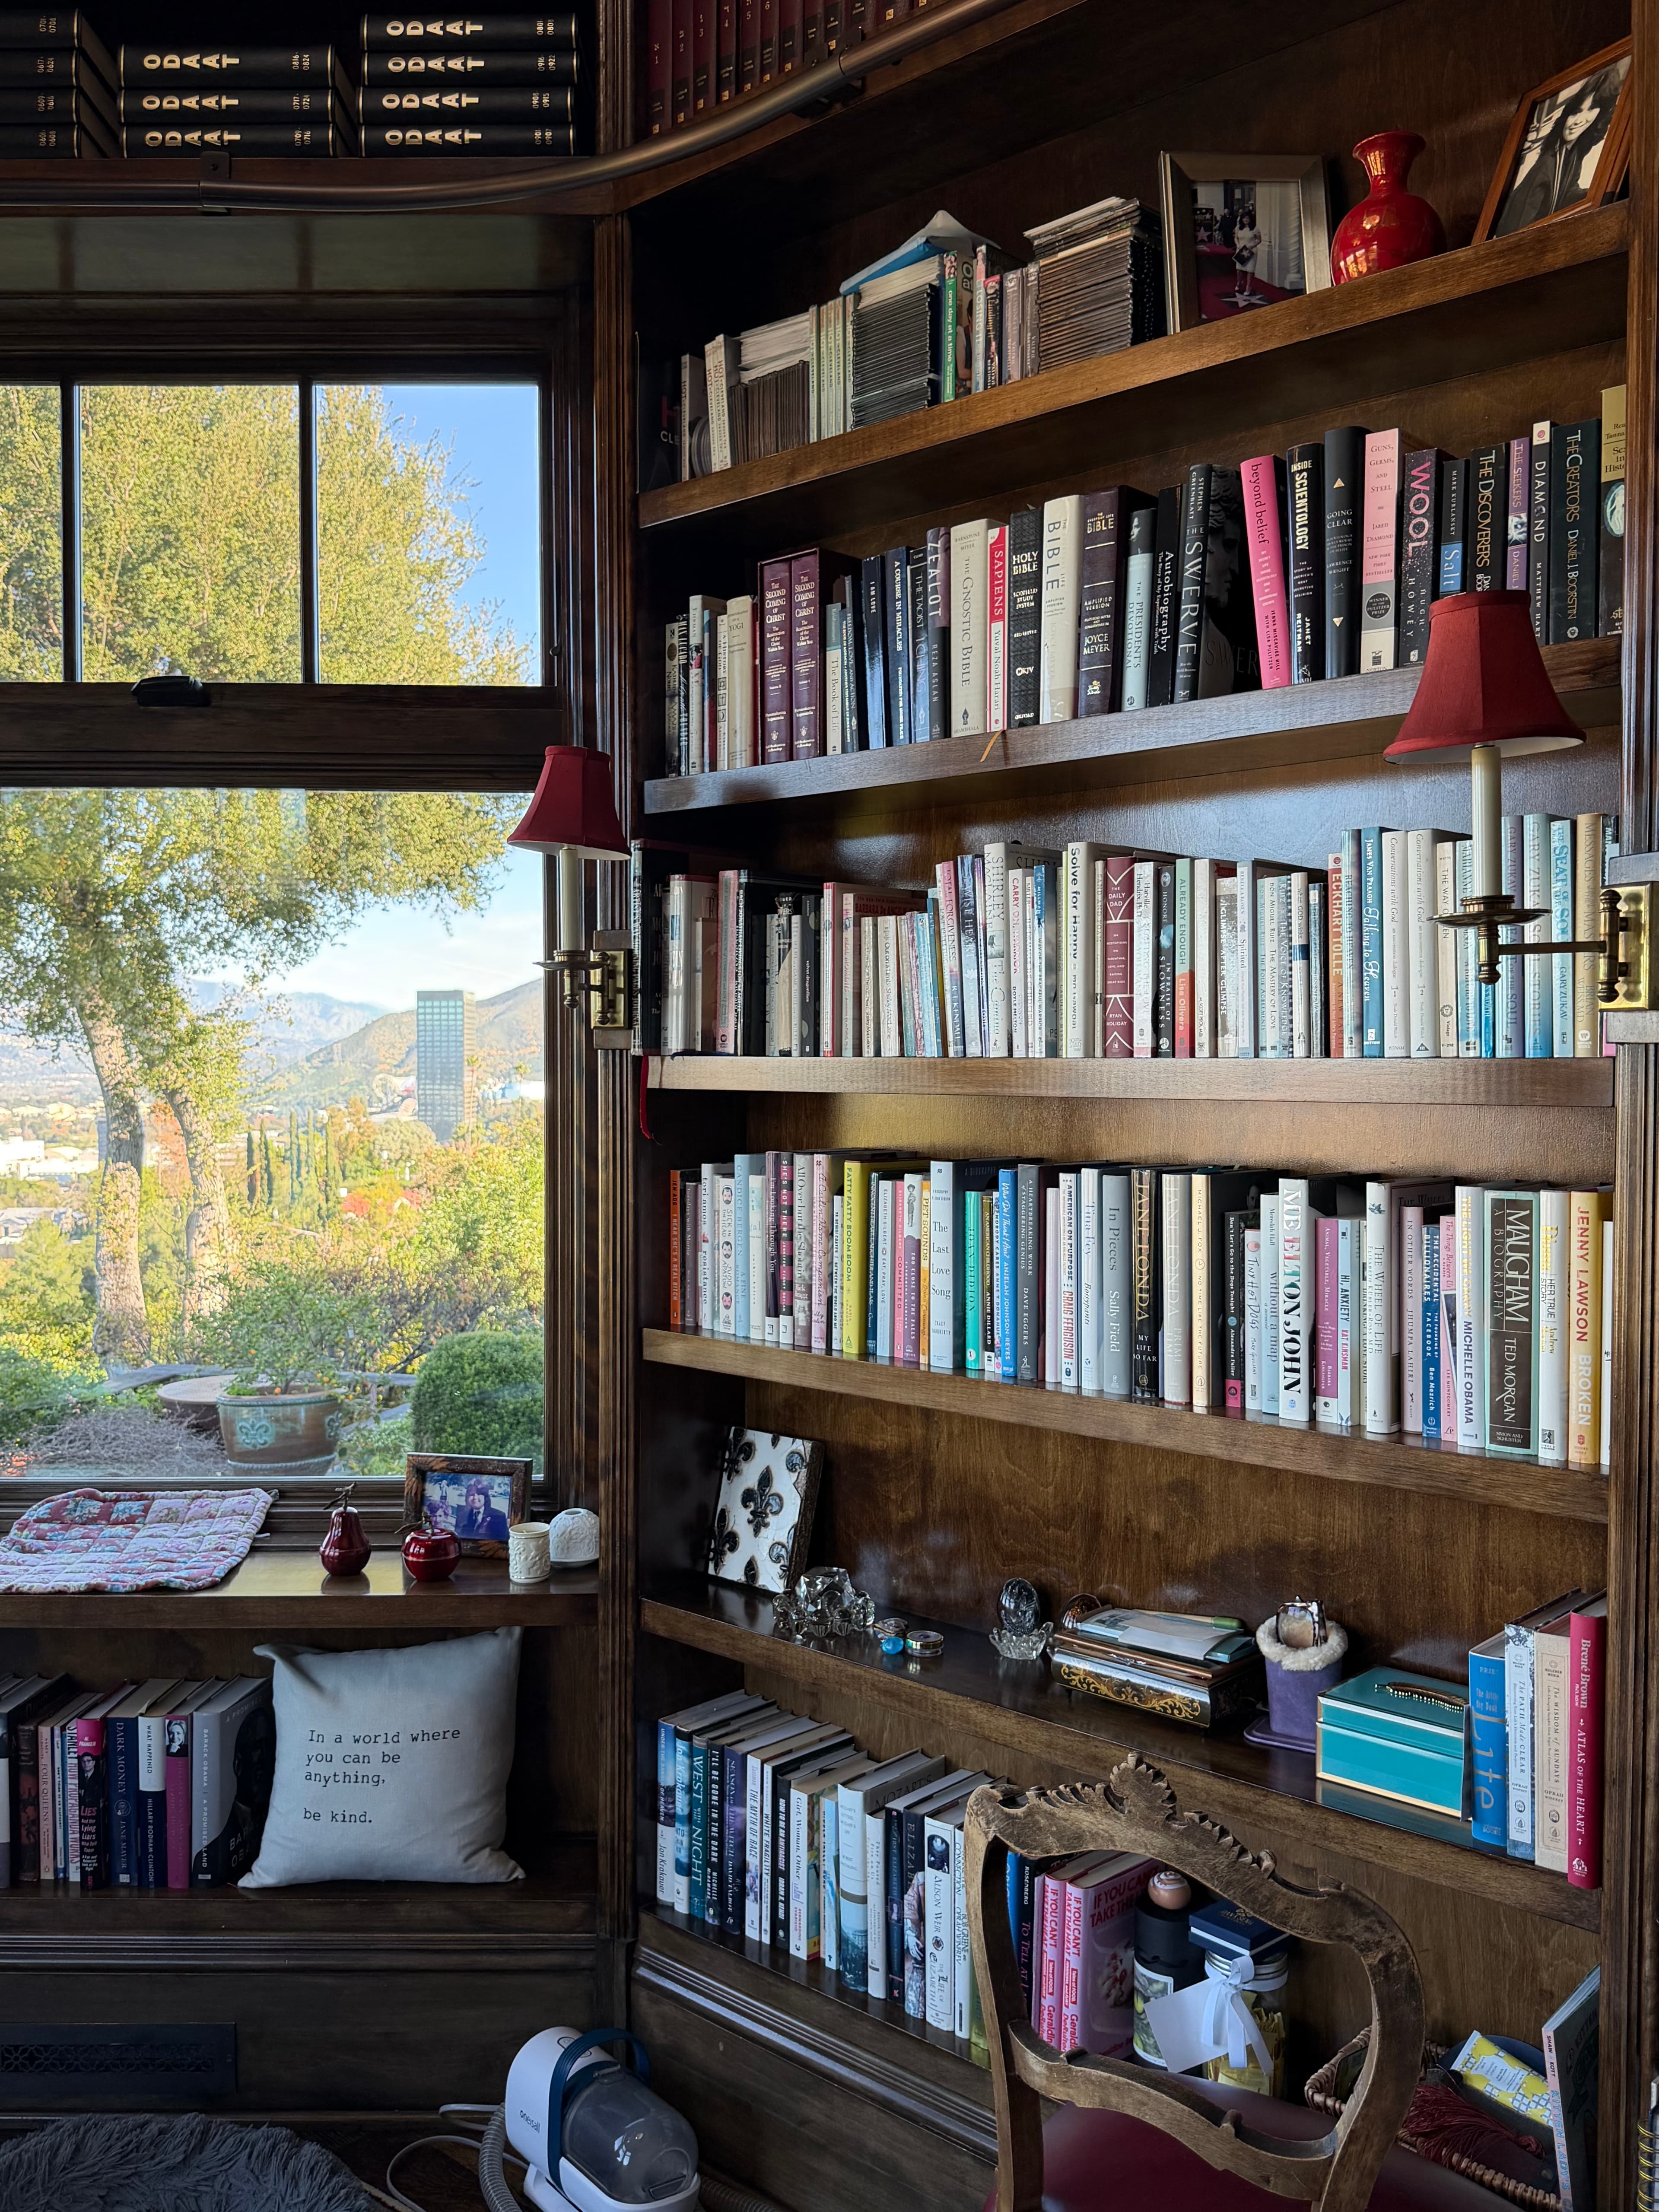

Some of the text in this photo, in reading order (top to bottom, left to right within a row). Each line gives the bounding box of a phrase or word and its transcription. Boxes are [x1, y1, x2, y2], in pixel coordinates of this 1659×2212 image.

[386, 20, 483, 36] ODAAT
[143, 53, 239, 70] ODAAT
[388, 56, 485, 73] ODAAT
[142, 95, 239, 110] ODAAT
[382, 92, 479, 109] ODAAT
[145, 130, 241, 146] ODAAT
[385, 129, 482, 145] ODAAT
[1370, 443, 1394, 454] GUNS,
[1370, 456, 1395, 467] GERMS,
[1249, 463, 1270, 544] beyond belief
[1291, 459, 1312, 550] INSIDE SCIENTOLOGY
[1370, 483, 1392, 493] STEEL
[1408, 461, 1431, 558] WOOL
[1513, 467, 1522, 508] SEEKERS
[1566, 454, 1583, 522] CREATORS
[1087, 517, 1115, 534] BIBLE
[1327, 509, 1353, 519] GOING
[1327, 518, 1353, 529] CLEAR
[1366, 532, 1394, 542] DIAMOND
[1372, 522, 1389, 530] JARED
[1476, 479, 1495, 568] DISCOVERERS
[928, 540, 941, 617] ZEALOT
[1013, 551, 1038, 564] HOLY
[1013, 562, 1038, 575] BIBLE
[1046, 520, 1062, 591] BIBLE
[1443, 549, 1460, 586] Salt
[995, 550, 1003, 616] SAPIENS
[1158, 551, 1174, 652] Autobiography
[1178, 527, 1205, 656] THE SWERVE
[1567, 570, 1579, 620] BOORSTIN
[729, 622, 744, 632] YOGI
[766, 613, 785, 624] CHRIST
[795, 607, 815, 618] CHRIST
[961, 576, 974, 686] GNOSTIC BIBLE
[1135, 601, 1143, 669] PRESIDENT'S
[1083, 643, 1110, 655] MEYER
[1084, 633, 1109, 645] JOYCE
[1071, 847, 1081, 911] Solve for
[1390, 837, 1398, 887] Conversations
[1416, 833, 1425, 885] Conversations
[992, 856, 1004, 921] SHIRLEY
[946, 899, 957, 961] FORGIVENESS
[1332, 874, 1343, 976] ECKHART TOLLE
[1239, 939, 1247, 969] Spirited
[1363, 906, 1380, 1001] Talking Heaven
[1559, 966, 1567, 1020] GARY ZUKAV
[932, 1242, 949, 1253] Last
[933, 1221, 948, 1233] The
[931, 1263, 950, 1275] Love
[1135, 1184, 1150, 1321] JANE FONDA
[1494, 1228, 1504, 1319] BIOGRAPHY
[1506, 1209, 1530, 1322] MAUGHAM
[931, 1285, 951, 1300] Song
[1107, 1208, 1121, 1352] In Pieces Sally Field
[1283, 1189, 1302, 1394] ME ELTON JOHN
[1340, 1287, 1351, 1322] ANXIETY
[1374, 1245, 1385, 1354] THE WHEEL LIFE
[1062, 1290, 1074, 1360] CRAIG FERGUSON
[1247, 1304, 1260, 1329] DOGS
[1267, 1271, 1280, 1362] without map
[1576, 1206, 1592, 1426] JENNY LAWSON BROKEN
[1464, 1321, 1474, 1424] MICHELLE OBAMA
[1504, 1338, 1517, 1361] TED
[1495, 1365, 1516, 1422] MORGAN
[1580, 1638, 1591, 1708] Brené Brown
[116, 1722, 126, 1795] DARK MONEY
[305, 1751, 400, 1766] you can be
[308, 1729, 460, 1744] In a world where
[305, 1770, 385, 1787] anything,
[1576, 1729, 1586, 1834] ATLAS HEART
[304, 1808, 372, 1823] be kind.
[691, 1755, 704, 1886] WEST NIGHT
[658, 1858, 667, 1894] Krakauer
[934, 1875, 943, 1933] ALISON WEIR
[1049, 1895, 1058, 1948] YOU CAN'T
[1071, 1905, 1082, 1957] YOU CAN'T
